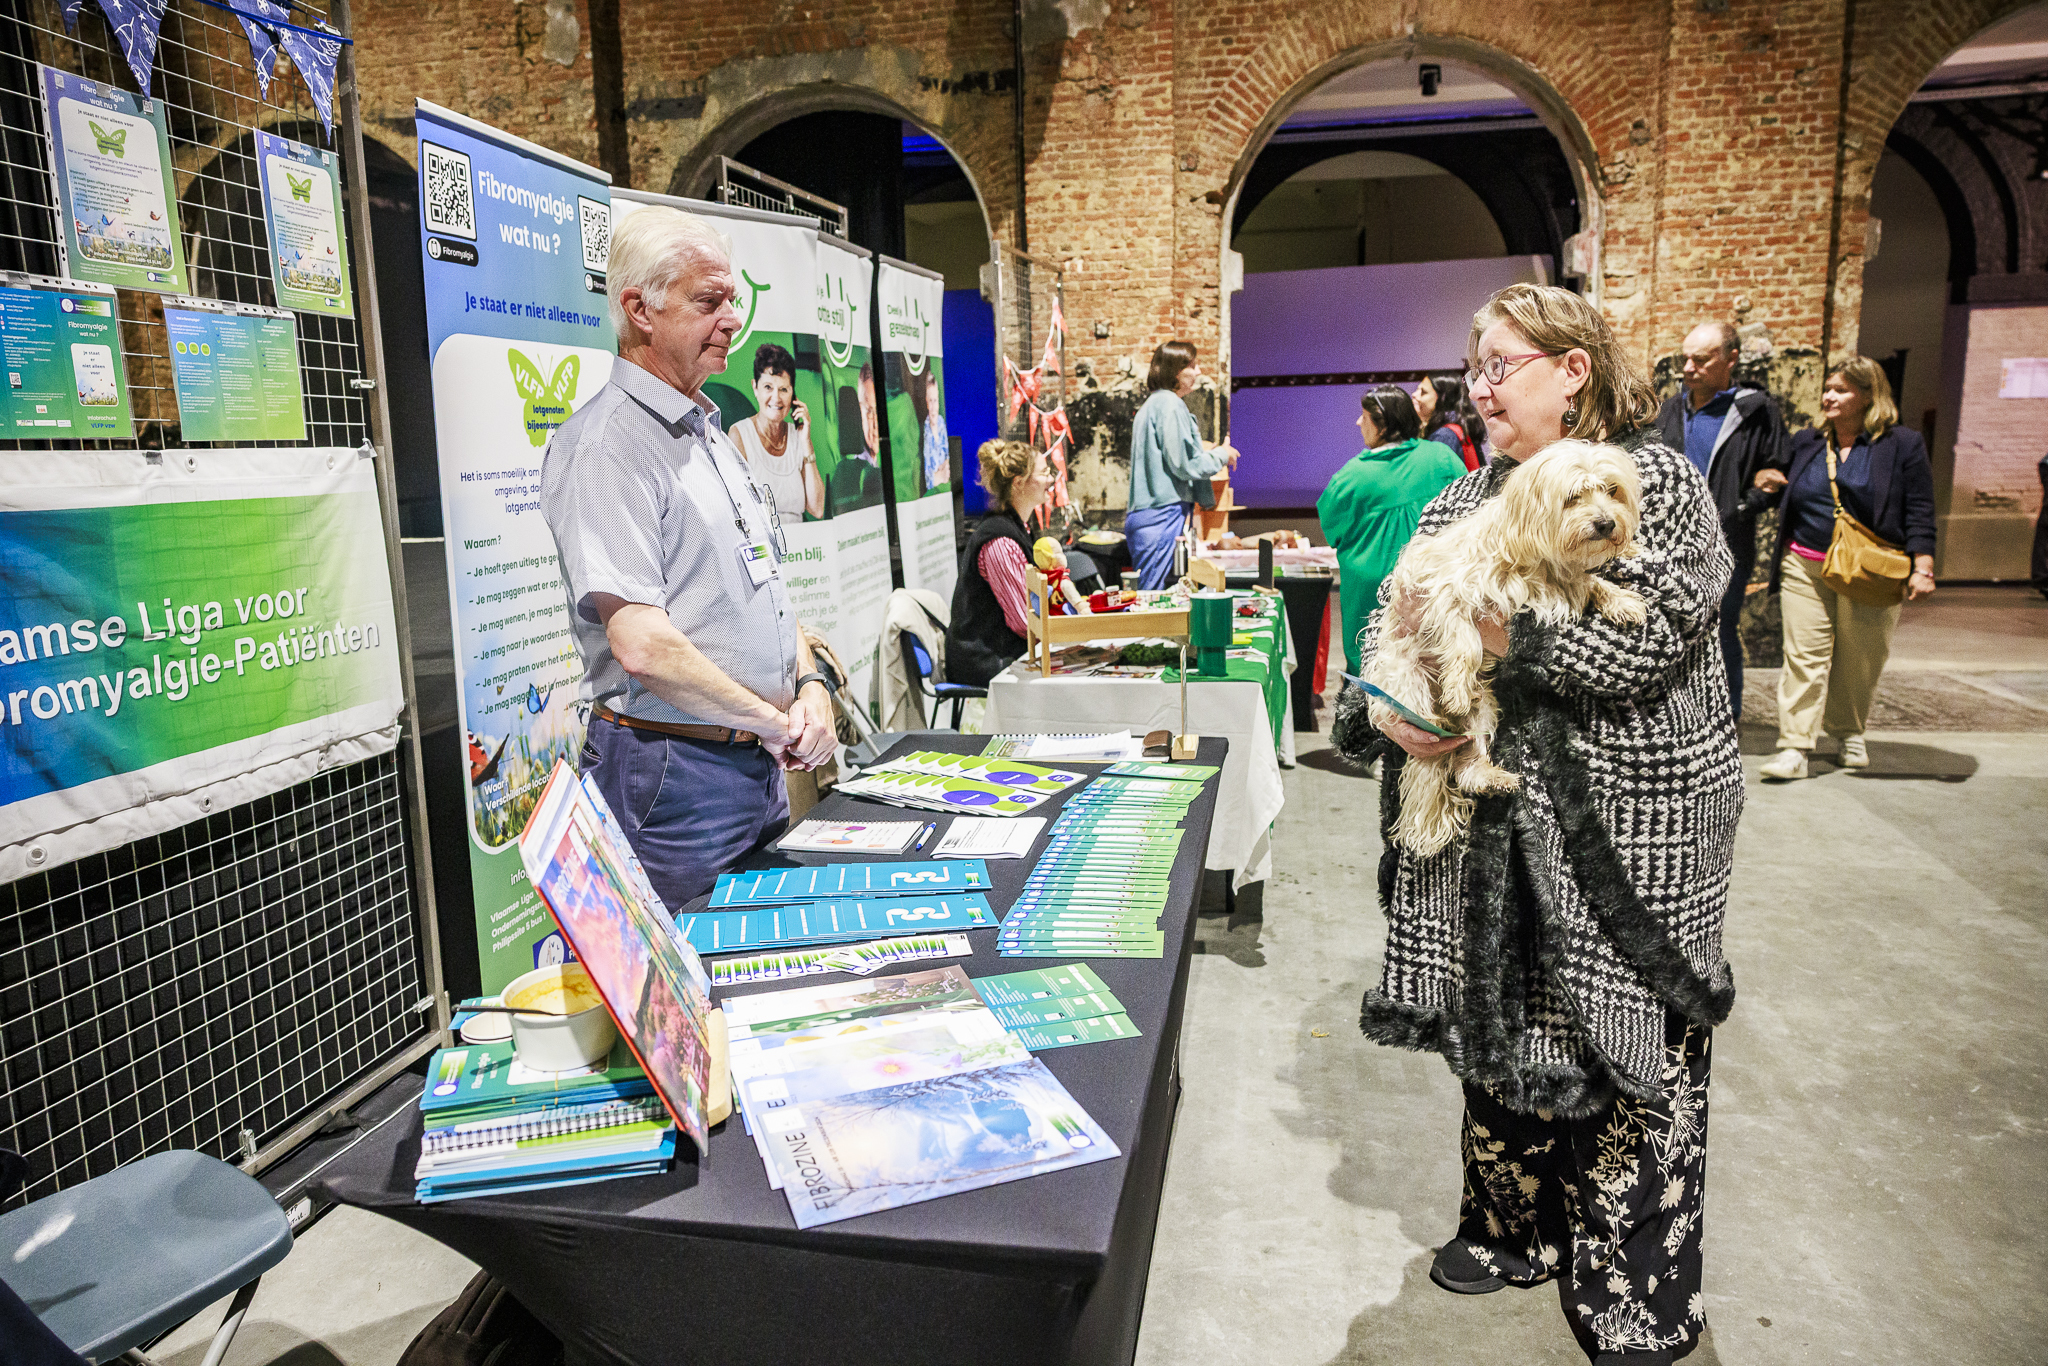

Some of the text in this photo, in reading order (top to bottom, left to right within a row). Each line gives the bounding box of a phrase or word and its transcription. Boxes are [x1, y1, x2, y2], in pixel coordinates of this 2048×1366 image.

[478, 170, 574, 225] Fibromyalgie
[499, 223, 561, 255] wat nu ?
[442, 246, 474, 262] Fibromyalgie
[465, 292, 601, 327] Je staat er niet alleen voor
[68, 321, 108, 331] Fibromyalgie
[516, 363, 545, 400] VLFP
[554, 362, 573, 402] VLFP
[532, 405, 565, 416] lotgenoten
[460, 468, 540, 482] Het is soms moeilijk om
[494, 484, 529, 497] omgeving,
[473, 567, 483, 578] Je
[484, 562, 501, 576] hoeft
[502, 561, 518, 574] geen
[519, 557, 539, 568] uitleg
[540, 555, 547, 564] te
[805, 547, 826, 562] blij.
[476, 595, 485, 605] Je
[487, 592, 502, 603] mag
[502, 587, 526, 600] zeggen
[527, 583, 540, 593] wat
[542, 581, 548, 589] er
[549, 580, 558, 590] op
[820, 575, 830, 584] en
[799, 591, 830, 602] slimme
[478, 623, 488, 633] Je
[489, 619, 504, 630] mag
[504, 614, 528, 625] wenen,
[529, 609, 536, 622] je
[537, 606, 553, 618] mag
[820, 605, 827, 618] je
[829, 604, 838, 614] de
[0, 586, 308, 667] amse Liga voor
[481, 650, 490, 660] Je
[491, 645, 506, 657] mag
[506, 641, 522, 651] naar
[522, 637, 529, 650] je
[530, 630, 559, 643] woorden
[482, 677, 492, 688] Je
[493, 672, 508, 683] mag
[508, 665, 530, 680] praten
[531, 660, 546, 671] over
[548, 655, 559, 665] het
[485, 704, 494, 715] Je
[495, 700, 509, 712] mag
[510, 691, 534, 705] zeggen
[556, 679, 569, 689] moe
[485, 783, 531, 811] Verschillende
[490, 892, 534, 923] Vlaamse Liga
[492, 912, 546, 953] Philipssite 5 bus 1
[785, 1132, 836, 1211] FIBROZINE
